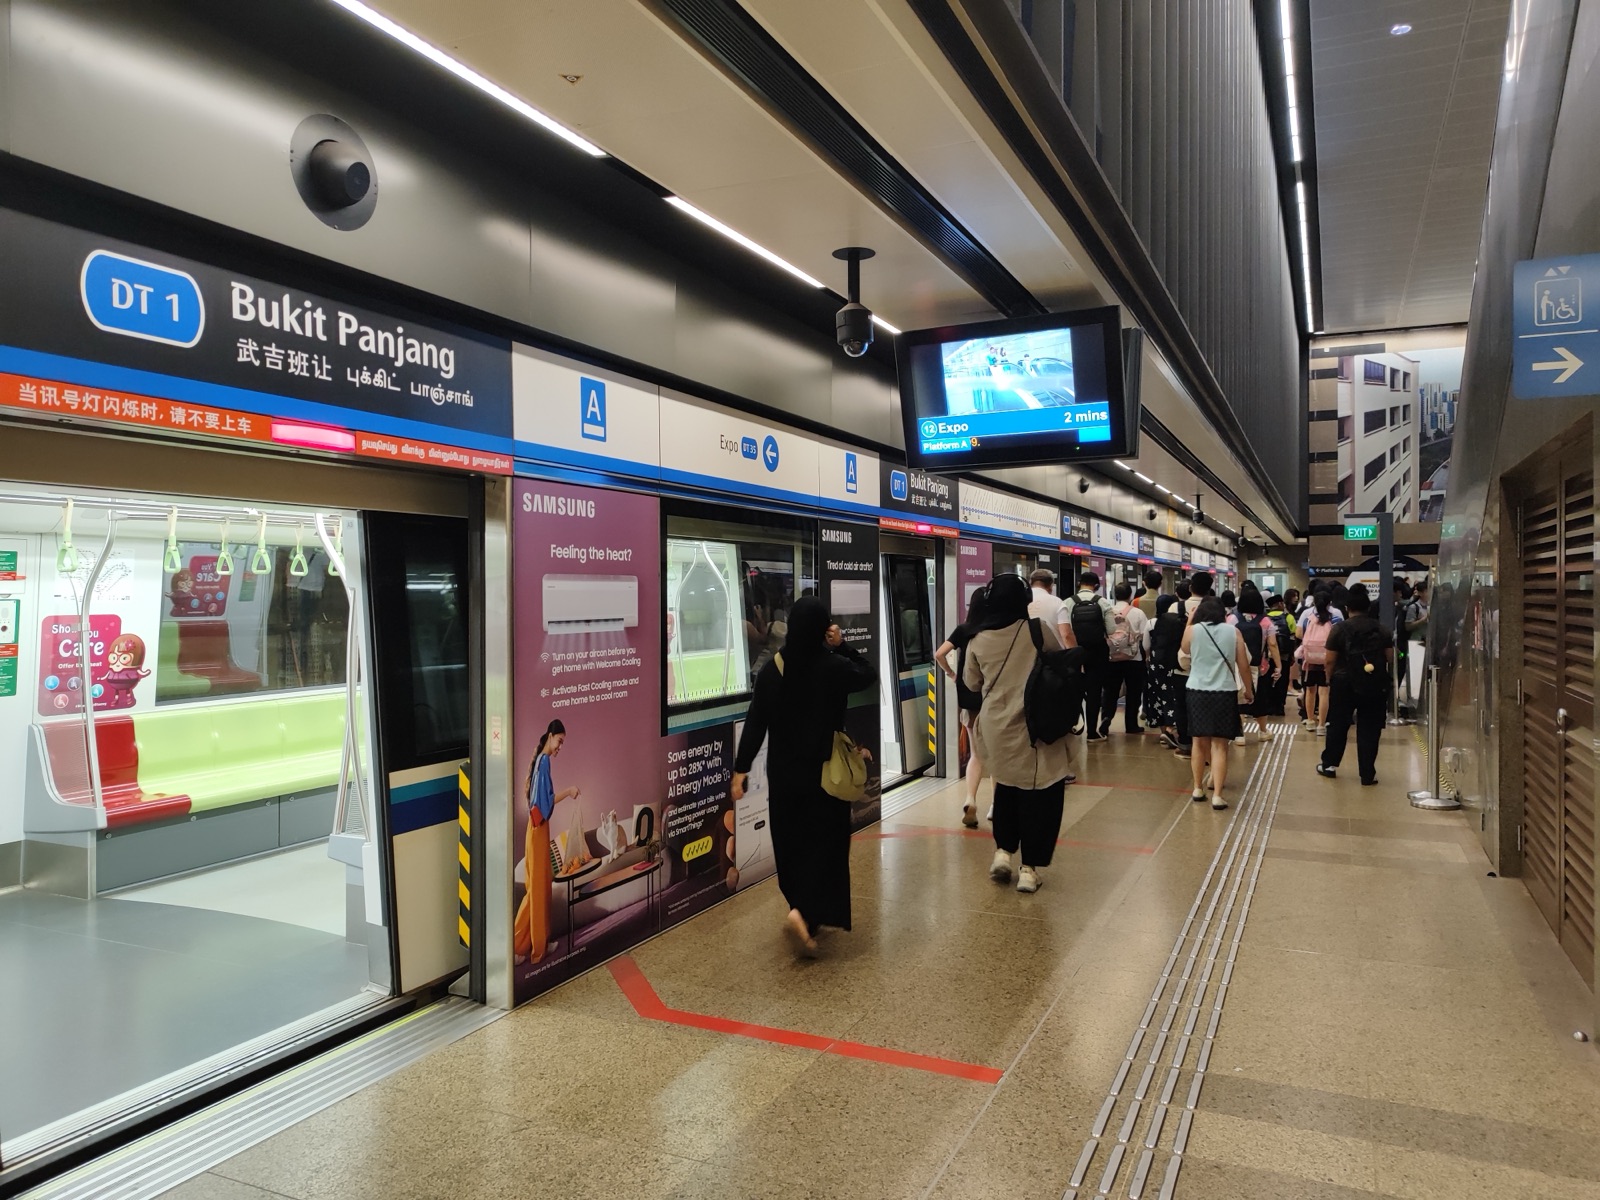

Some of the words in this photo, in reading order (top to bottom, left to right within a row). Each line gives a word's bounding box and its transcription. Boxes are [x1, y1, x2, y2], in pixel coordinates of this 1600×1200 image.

[111, 278, 154, 315] DT
[165, 293, 180, 322] 1
[231, 281, 327, 341] Bukit
[337, 310, 455, 379] Panjang
[236, 338, 332, 381] 武吉班让
[347, 366, 401, 392] புக்கிட்
[410, 381, 474, 407] பாஞ்சாங்
[586, 389, 602, 422] A
[923, 424, 936, 434] 12
[938, 422, 969, 436] Expo
[1063, 411, 1073, 423] 2
[1075, 410, 1108, 423] mins
[720, 434, 739, 455] Expo
[923, 440, 959, 451] Platform
[960, 440, 968, 449] A
[848, 460, 856, 481] A
[910, 473, 926, 491] Bukit
[927, 478, 949, 499] Panjang
[522, 492, 596, 518] SAMSUNG
[821, 528, 852, 544] SAMSUNG
[1348, 527, 1367, 538] EXIT
[550, 544, 587, 564] Feeling
[588, 546, 605, 561] the
[606, 548, 633, 562] heat?
[552, 652, 566, 661] Turn
[566, 652, 575, 660] on
[575, 651, 589, 661] your
[589, 648, 607, 658] aircon
[607, 646, 626, 656] before
[626, 647, 636, 657] you
[552, 664, 563, 677] get
[563, 663, 581, 673] home
[582, 661, 595, 670] with
[596, 659, 621, 669] Welcome
[621, 656, 641, 667] Cooling
[552, 685, 577, 696] Activate
[577, 683, 590, 693] Fast
[590, 679, 612, 690] Cooling
[612, 678, 628, 687] mode
[628, 677, 640, 685] and
[552, 698, 570, 708] come
[570, 696, 588, 706] home
[589, 694, 595, 703] to
[601, 692, 613, 701] cool
[613, 690, 628, 699] room
[667, 751, 687, 764] Save
[687, 742, 714, 758] energy
[713, 740, 723, 754] by
[667, 769, 679, 784] up
[679, 765, 688, 778] to
[706, 755, 722, 770] with
[667, 785, 676, 799] AI
[676, 779, 702, 796] Energy
[702, 771, 723, 788] Mode
[667, 807, 678, 818] and
[678, 801, 697, 814] estimate
[697, 797, 706, 809] your
[715, 791, 727, 801] while
[706, 804, 720, 816] usage
[667, 829, 676, 839] via
